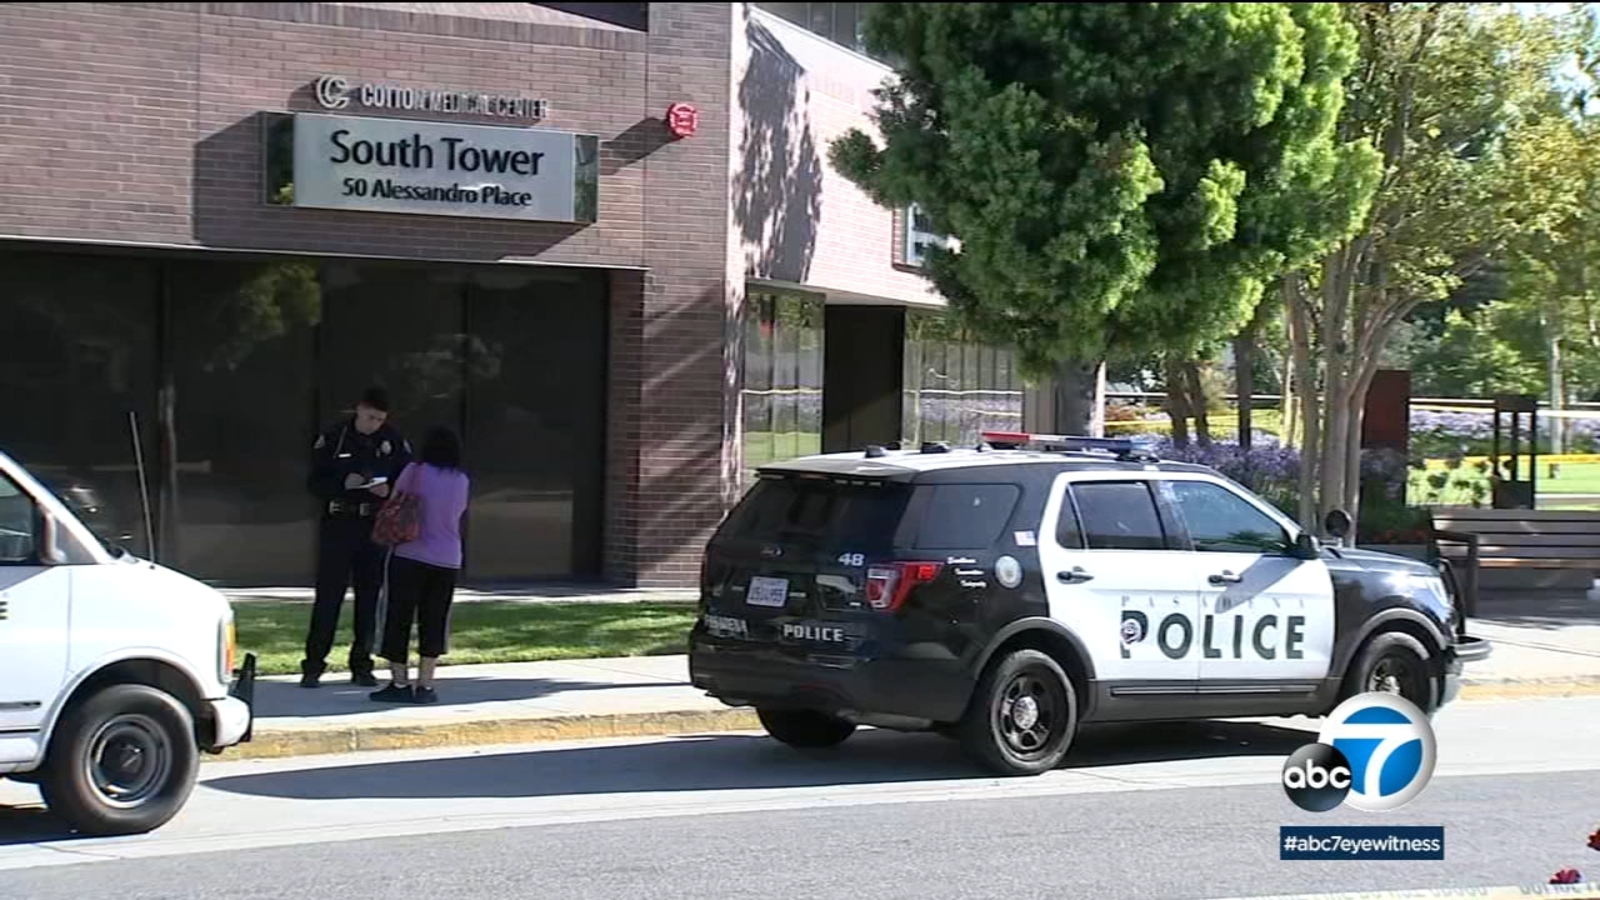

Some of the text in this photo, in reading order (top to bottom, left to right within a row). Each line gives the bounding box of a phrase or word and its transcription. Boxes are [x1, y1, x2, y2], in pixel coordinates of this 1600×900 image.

[361, 83, 427, 110] COTTON
[330, 129, 545, 176] South Tower
[342, 177, 533, 207] 50 Alessandro Place
[838, 553, 865, 567] 48
[783, 624, 844, 642] POLICE
[1120, 610, 1306, 660] POLICE
